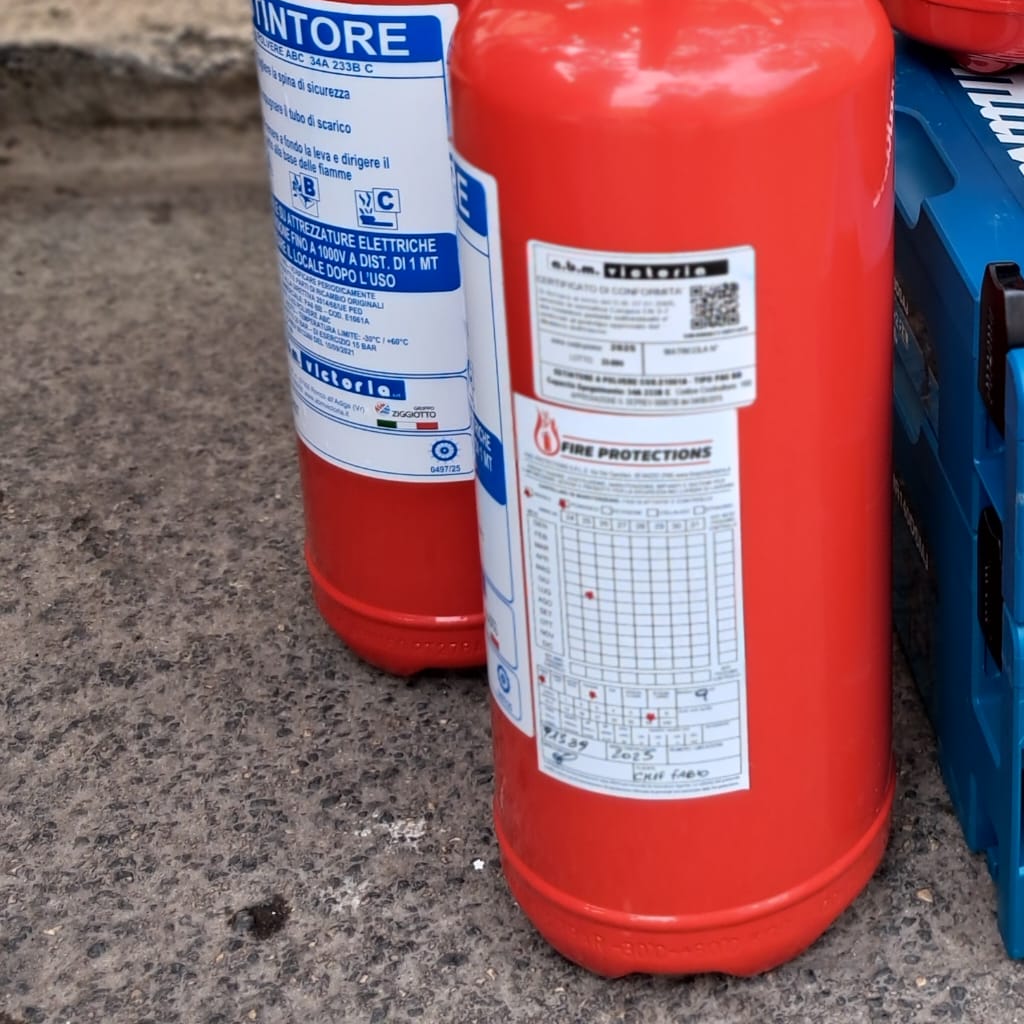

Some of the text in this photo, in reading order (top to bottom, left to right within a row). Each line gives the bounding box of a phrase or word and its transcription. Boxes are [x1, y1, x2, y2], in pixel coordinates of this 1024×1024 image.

[286, 50, 361, 72] ABC 34A 233B
[278, 71, 350, 100] spina sicurezza
[289, 108, 352, 134] tubo scarico
[298, 156, 352, 181] delle fiamme
[313, 146, 380, 170] leva dirigere
[303, 176, 394, 210] B C
[287, 212, 356, 248] ATTREZZATURE
[358, 235, 438, 253] ELETTRICHE
[292, 248, 396, 288] LOCALE DOPO L'USO
[318, 244, 439, 270] 1000V A DIST. DI MT
[318, 278, 376, 300] PERIODICAMENTE
[347, 296, 384, 310] ORIGINALI
[306, 360, 392, 398] victoria
[392, 410, 436, 419] ZIGGIOTTO
[560, 440, 712, 462] FIRE PROTECTIONS
[611, 748, 654, 762] 2025
